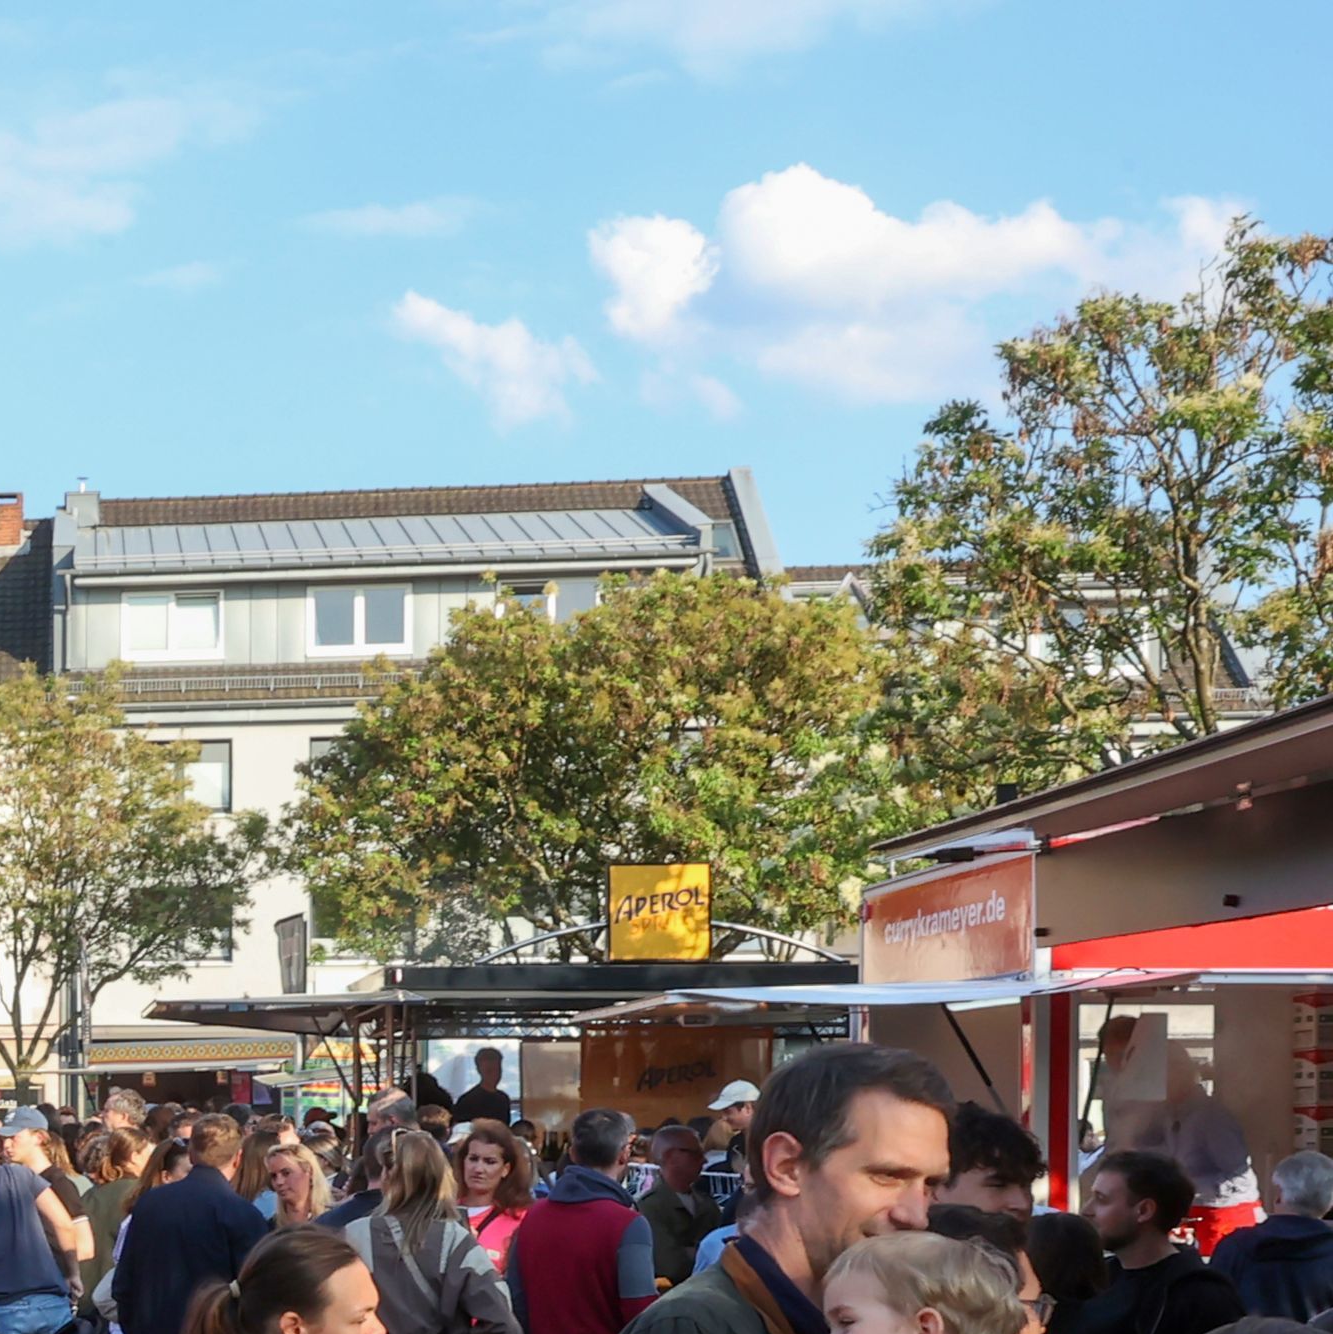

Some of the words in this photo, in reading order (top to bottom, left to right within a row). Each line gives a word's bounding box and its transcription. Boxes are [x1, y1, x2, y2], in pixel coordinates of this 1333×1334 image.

[614, 886, 705, 925] APEROL
[884, 889, 1006, 947] currykrameyer.de
[636, 1060, 717, 1092] APEROL
